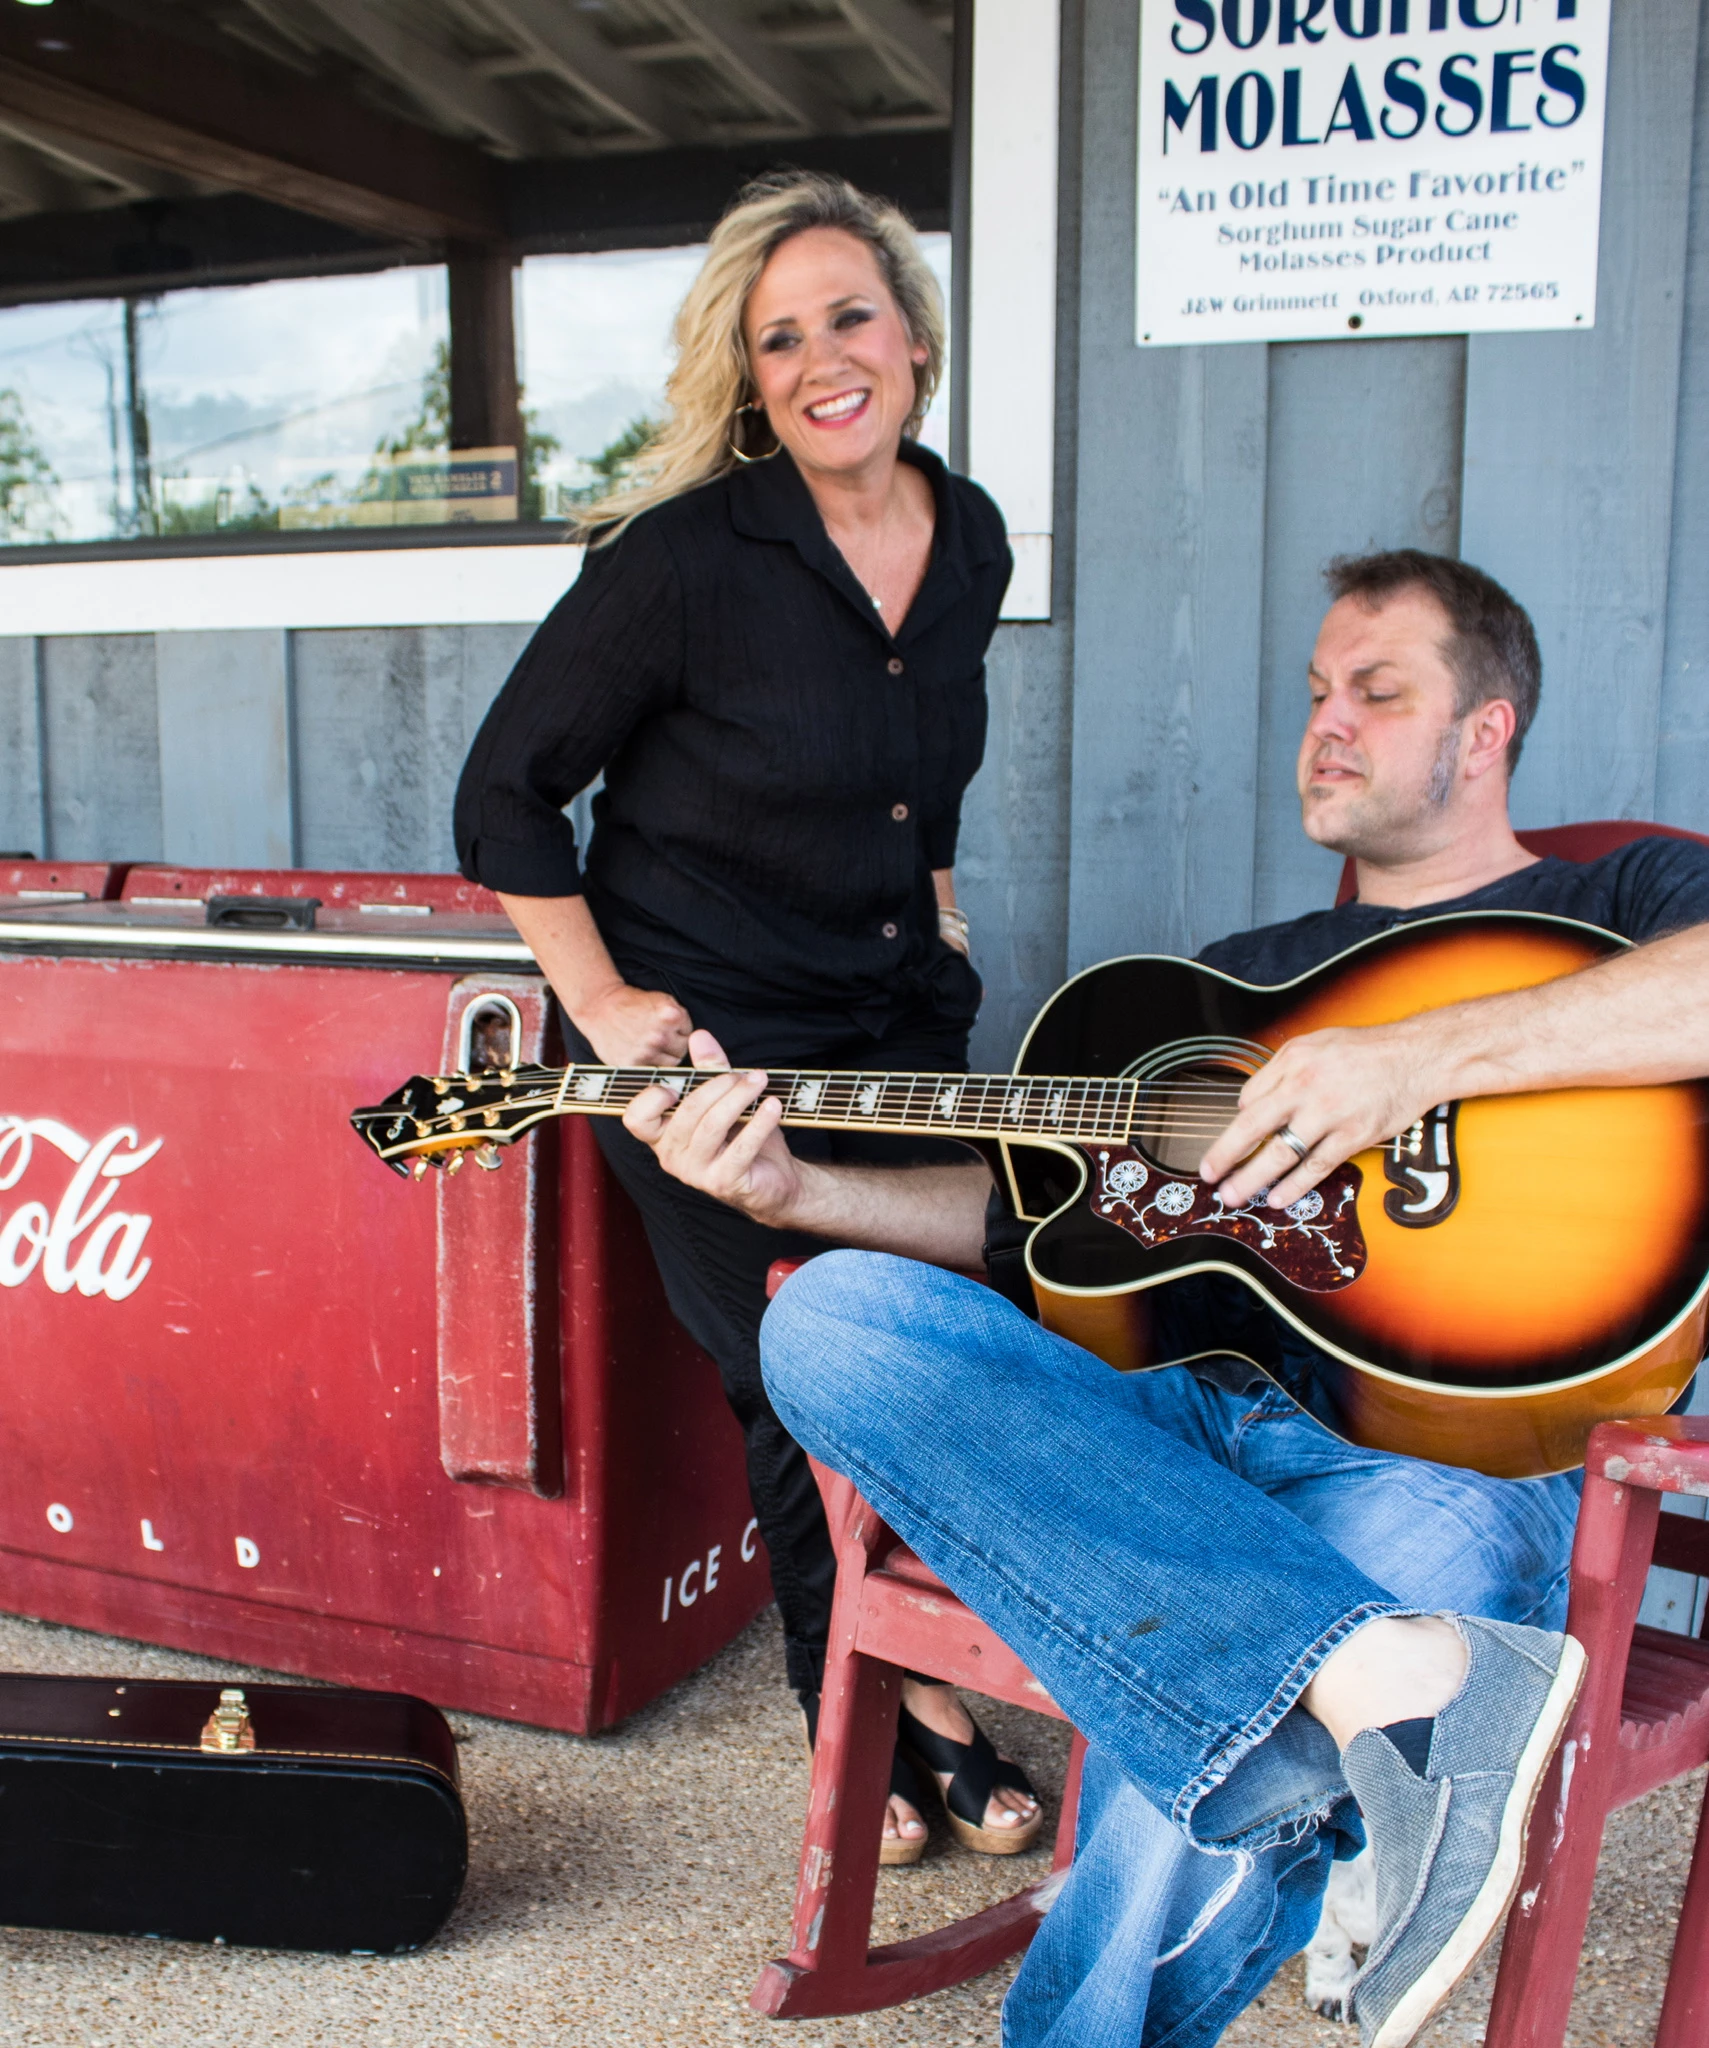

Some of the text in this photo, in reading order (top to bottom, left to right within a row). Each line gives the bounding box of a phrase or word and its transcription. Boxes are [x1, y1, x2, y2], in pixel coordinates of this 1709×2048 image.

[1171, 0, 1577, 54] SORG
[1163, 44, 1586, 155] MOLASSES
[1229, 179, 1289, 210] Old
[1302, 173, 1396, 205] Time
[1218, 209, 1518, 246] Sorghum Sugar Cane
[1239, 240, 1493, 273] Molasses Product
[1233, 292, 1339, 313] Grimmett
[1448, 285, 1479, 302] AR
[1488, 281, 1560, 301] 72565
[661, 1544, 722, 1623] ICE
